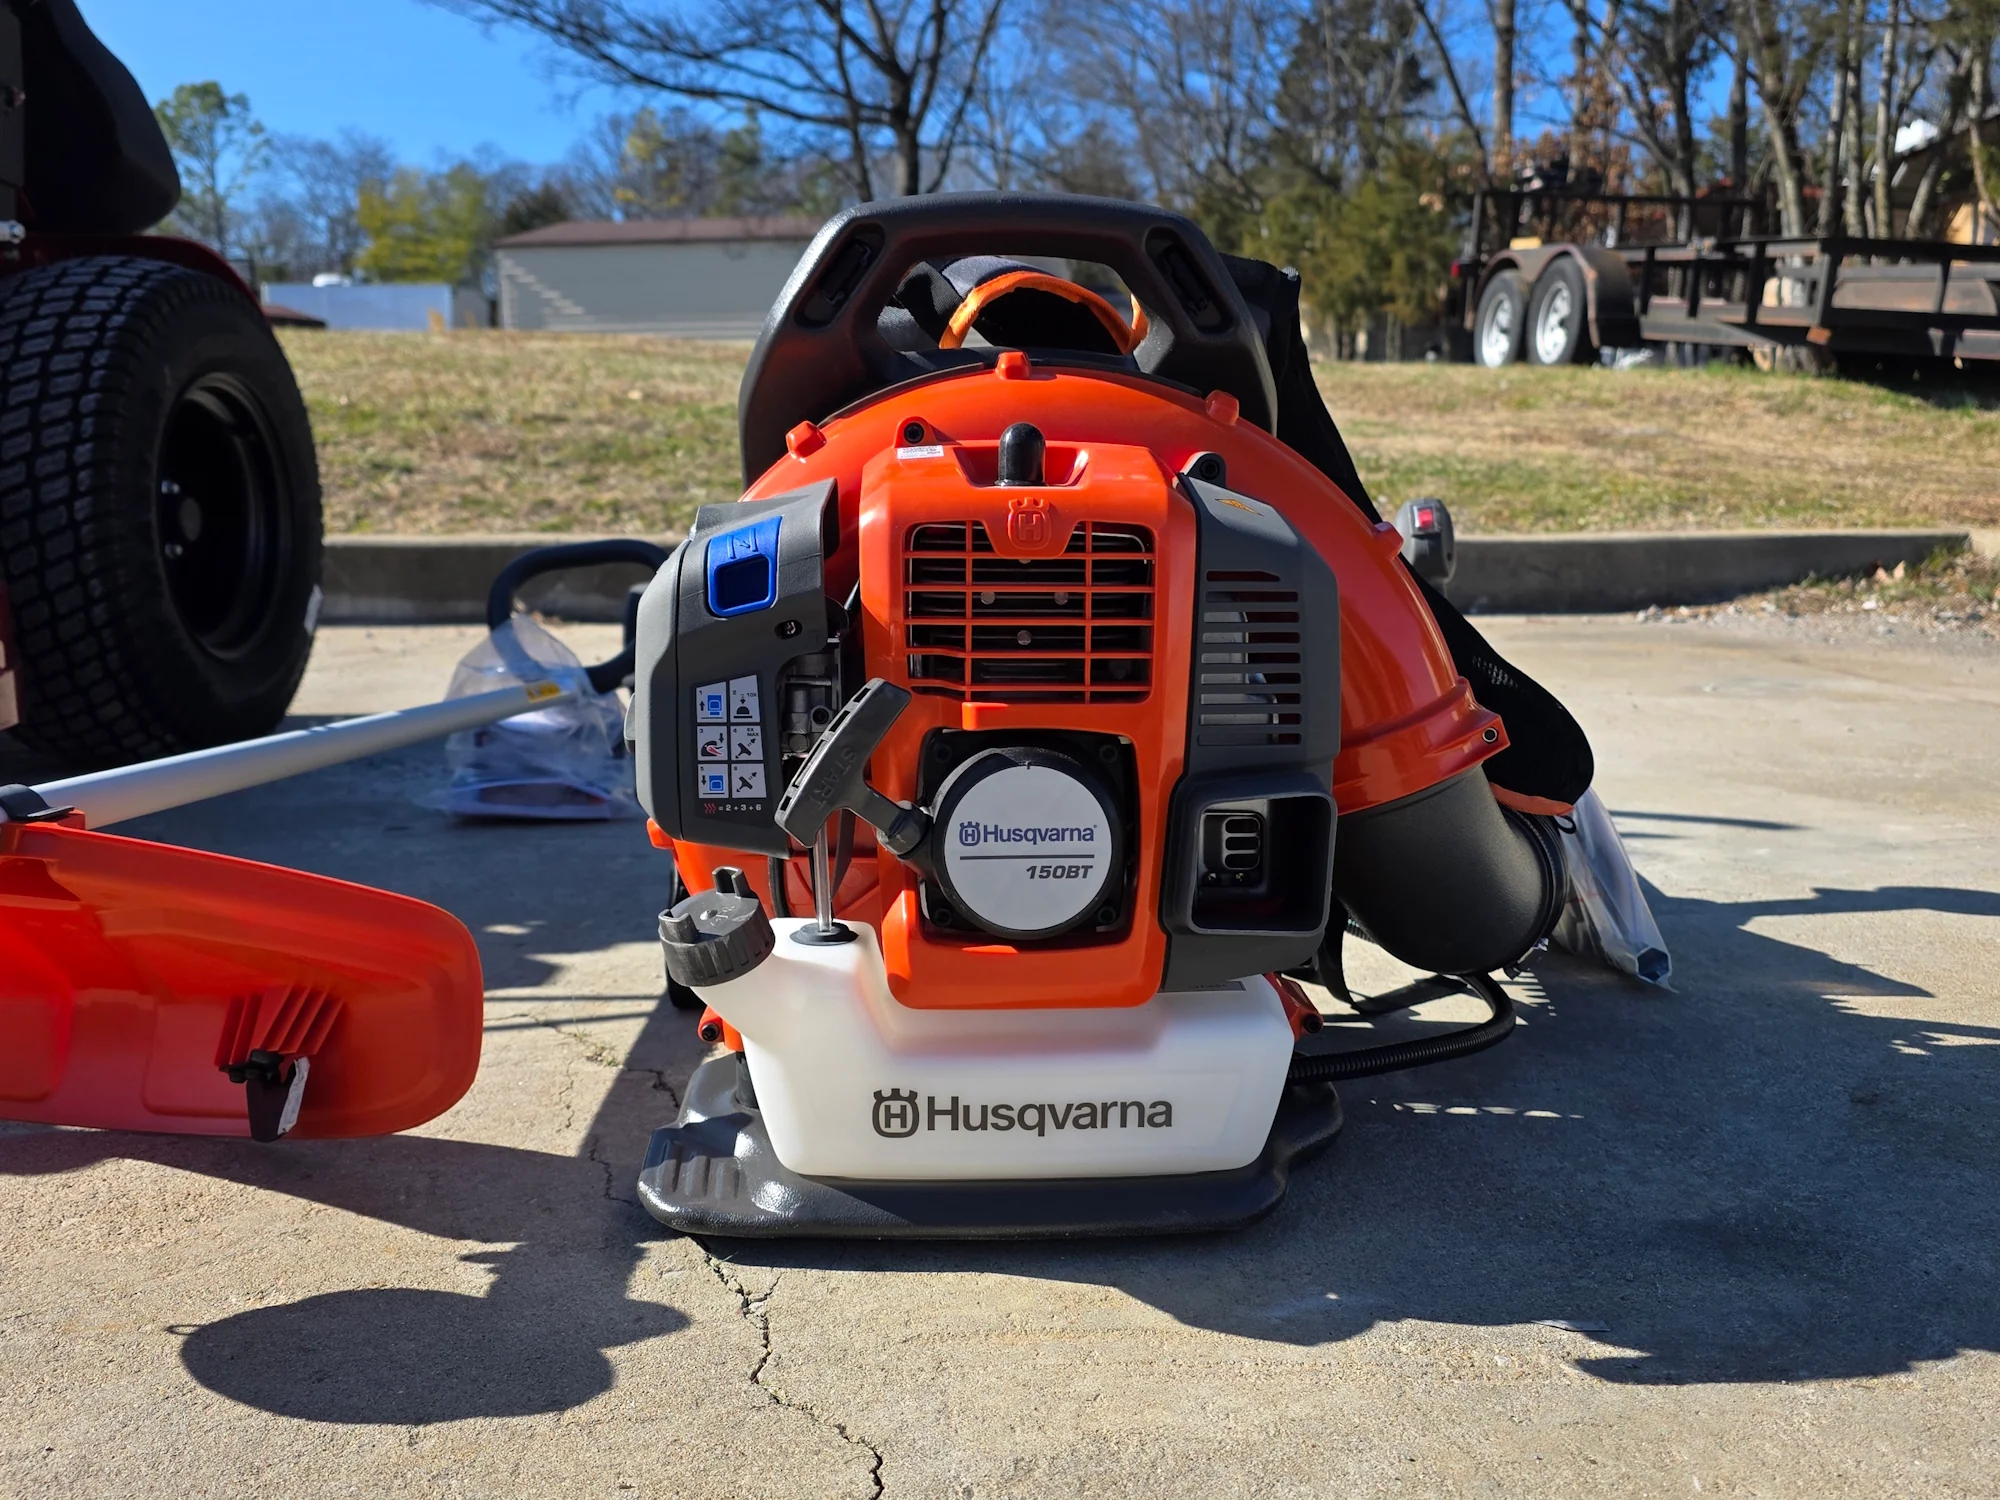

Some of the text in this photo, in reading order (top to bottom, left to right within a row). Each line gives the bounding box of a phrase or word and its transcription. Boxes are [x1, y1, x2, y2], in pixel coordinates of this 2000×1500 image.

[809, 747, 856, 812] START
[983, 824, 1094, 845] Husqvarna
[1026, 865, 1093, 879] 150BT
[927, 1096, 1173, 1137] Husqvarna
